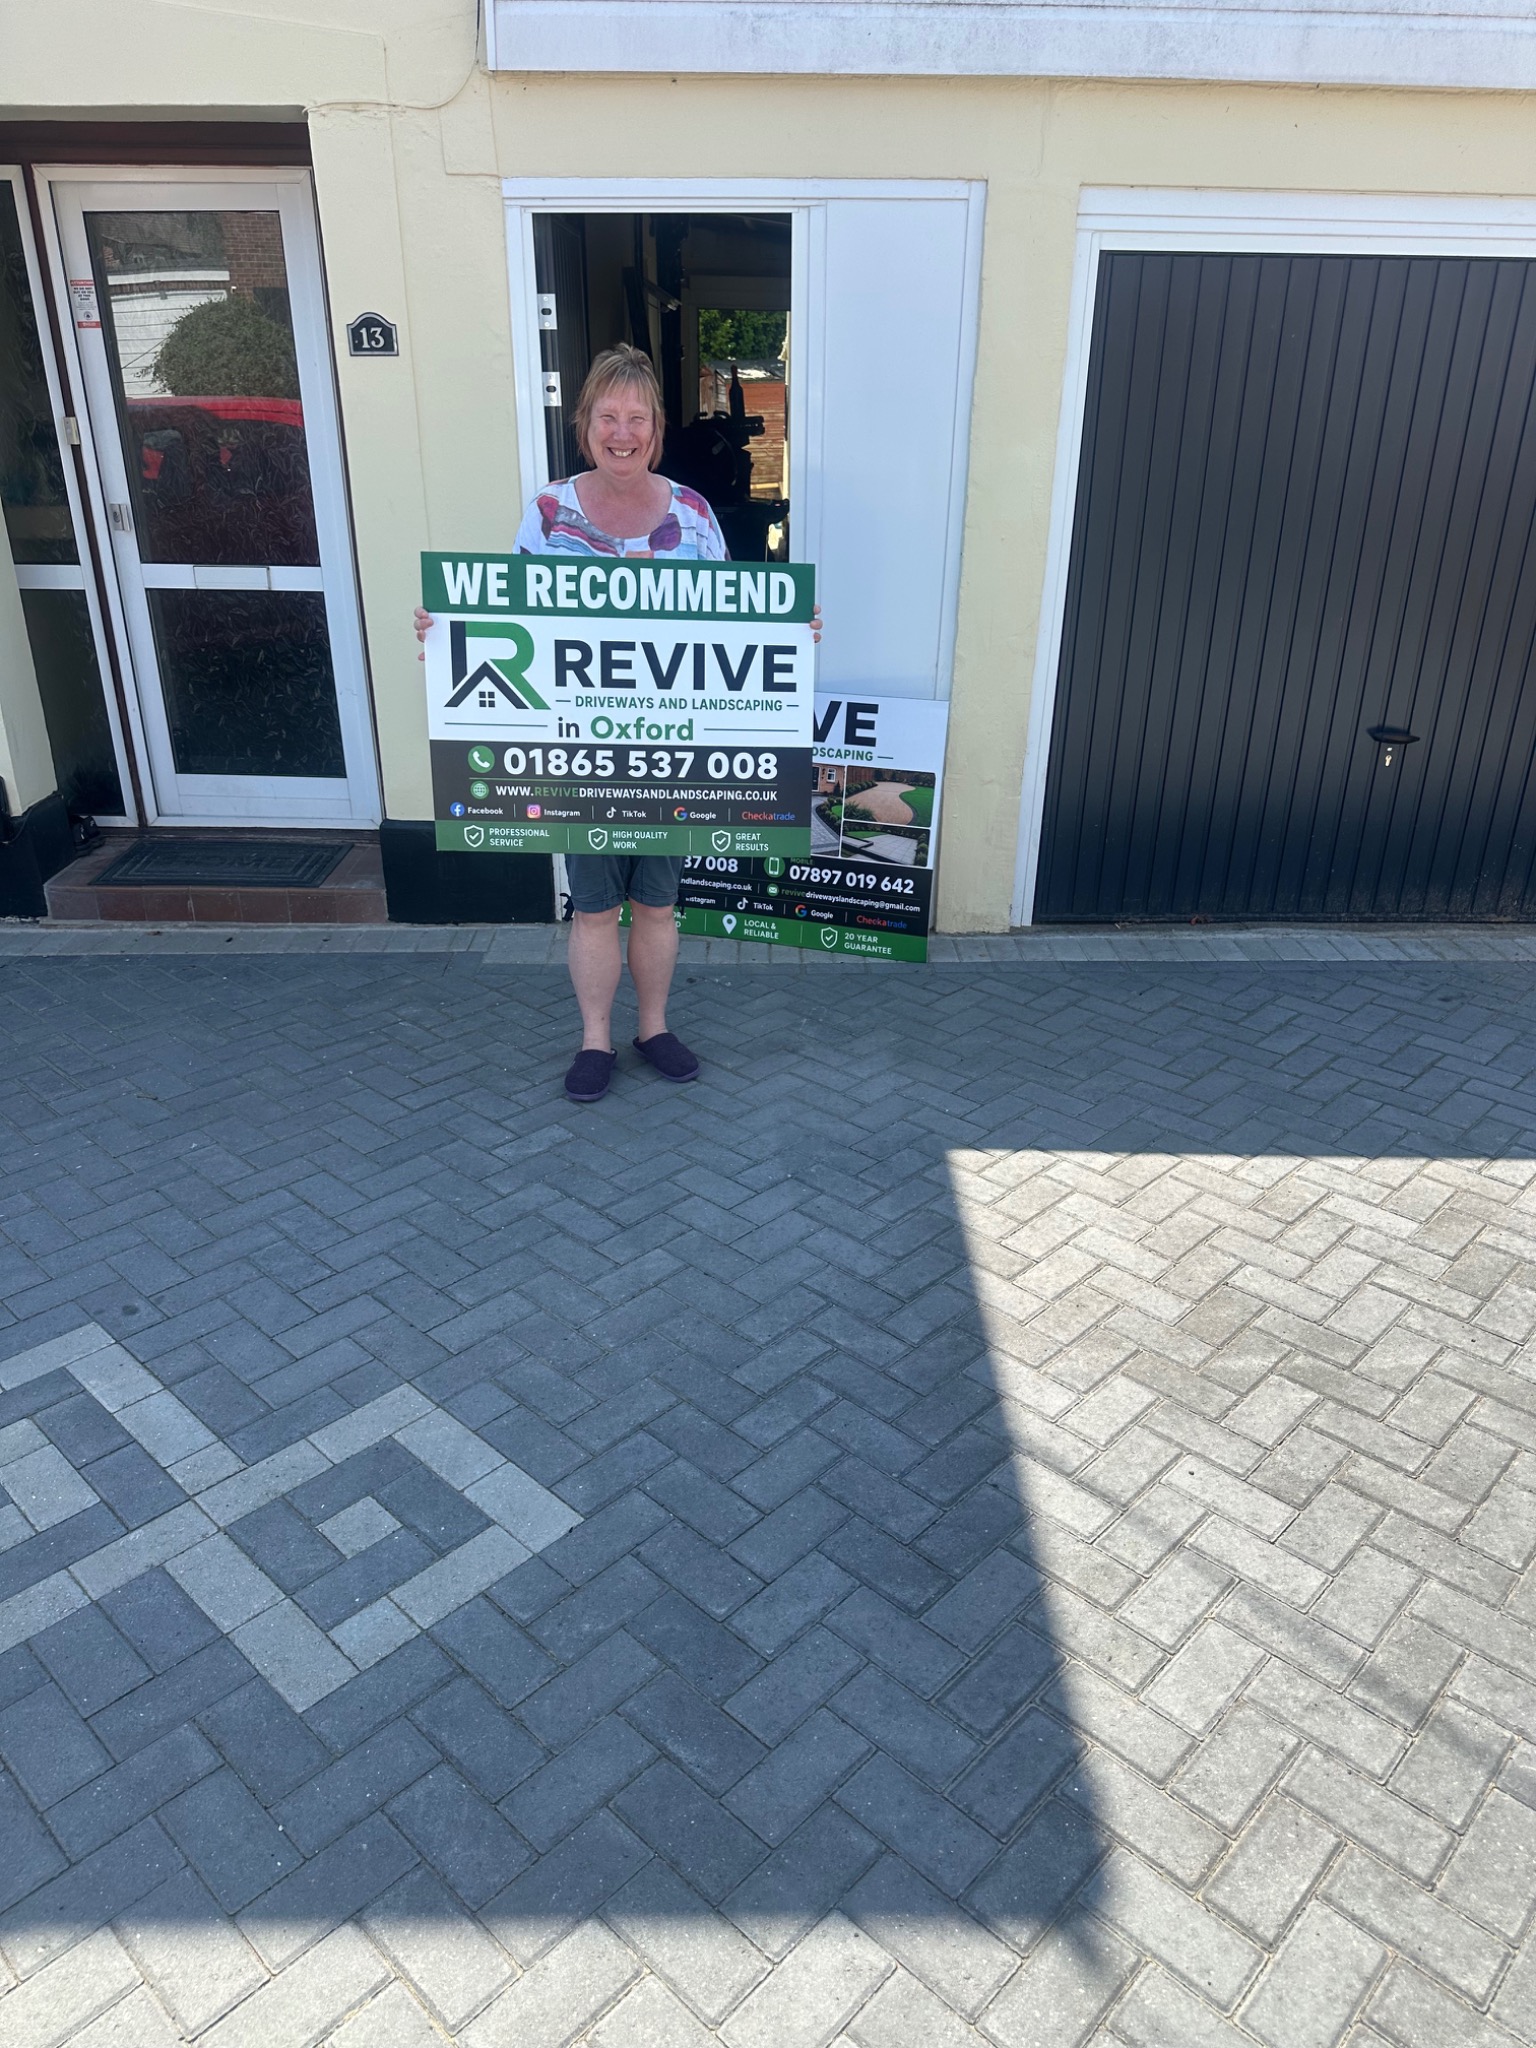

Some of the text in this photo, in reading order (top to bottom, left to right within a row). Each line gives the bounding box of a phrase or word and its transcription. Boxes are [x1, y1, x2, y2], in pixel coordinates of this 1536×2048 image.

[360, 327, 385, 349] 13
[441, 561, 796, 615] WE RECOMMEND
[553, 638, 798, 693] REVIVE
[575, 695, 783, 712] DRIVEWAYS AND LANDSCAPING
[557, 716, 694, 742] in Oxford
[812, 746, 874, 762] DSCAPING
[503, 747, 778, 780] 01865 537 008
[495, 785, 778, 802] WWW.REVIVEDRIVEWAYSANDLANDSCAPING.CO.UK
[467, 806, 504, 816] Facebook
[543, 808, 581, 818] Instagram
[622, 810, 647, 819] TikTok
[689, 812, 717, 821] Google
[741, 811, 796, 821] Checkatrade
[489, 827, 550, 837] PROFESSIONAL
[612, 830, 669, 840] HIGH QUALITY
[735, 832, 761, 841] GREAT
[489, 838, 524, 847] SERVICE
[612, 841, 637, 850] WORK
[735, 843, 769, 852] RESULTS
[684, 855, 739, 873] 37 008
[680, 877, 753, 891] ndlandscaping.co.uk
[789, 864, 914, 894] 07897 019 642
[753, 902, 774, 911] TikTok
[810, 909, 834, 919] Google
[744, 919, 777, 930] LOCAL &
[856, 914, 908, 929] Checkatrade
[743, 928, 779, 940] RELIABLE
[844, 932, 879, 943] 20 YEAR
[844, 942, 893, 955] GUARANTEE
